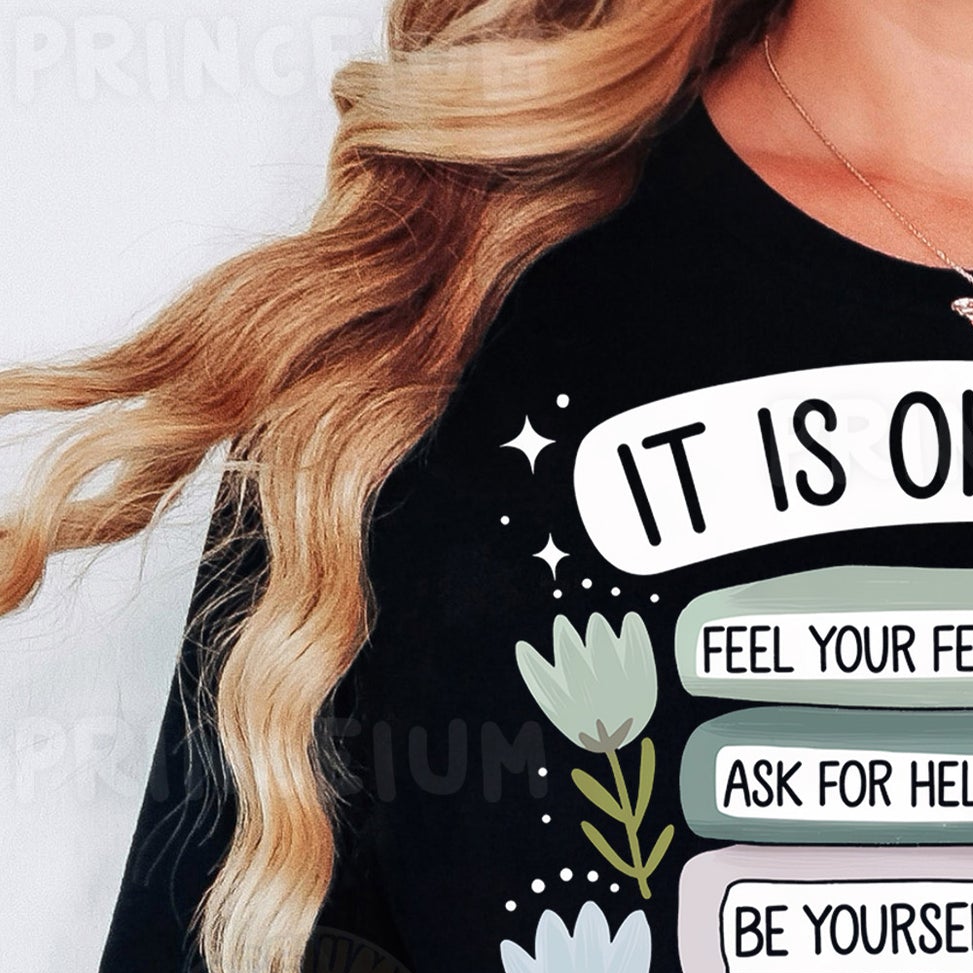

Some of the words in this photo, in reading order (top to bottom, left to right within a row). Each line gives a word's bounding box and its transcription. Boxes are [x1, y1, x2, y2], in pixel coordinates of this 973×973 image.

[617, 421, 706, 547] IT
[757, 398, 847, 512] IS
[703, 625, 795, 674] FEEL
[808, 624, 916, 674] YOUR
[723, 759, 803, 808] ASK
[819, 759, 893, 808] FOR
[735, 904, 789, 958] BE
